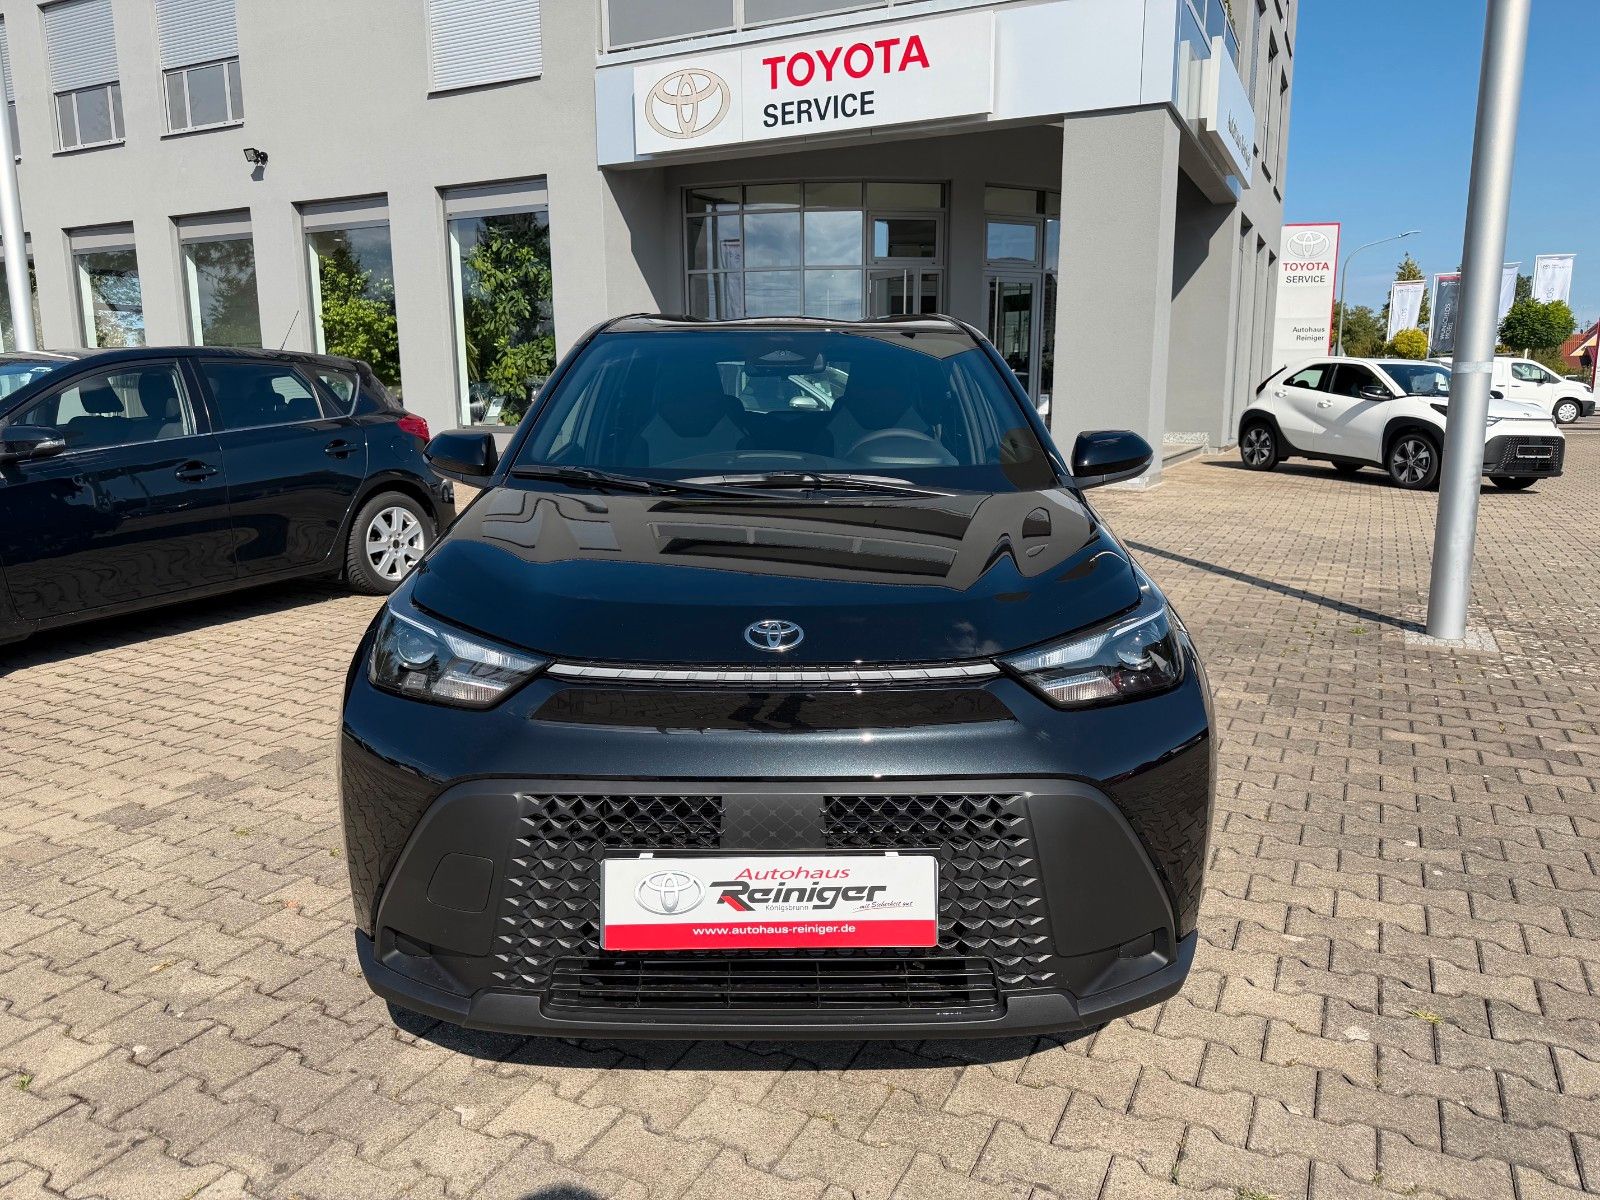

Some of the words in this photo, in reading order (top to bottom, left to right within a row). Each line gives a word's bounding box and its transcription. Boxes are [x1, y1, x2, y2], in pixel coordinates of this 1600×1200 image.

[762, 34, 930, 90] TOYOTA
[763, 90, 875, 128] SERVICE
[1283, 262, 1329, 271] TOYOTA
[1285, 275, 1325, 283] SERVICE
[734, 866, 851, 881] Autohaus
[709, 880, 887, 912] Reiniger
[765, 904, 809, 913] Königsbrunn
[692, 924, 857, 936] www.autohaus-reiniger.de
